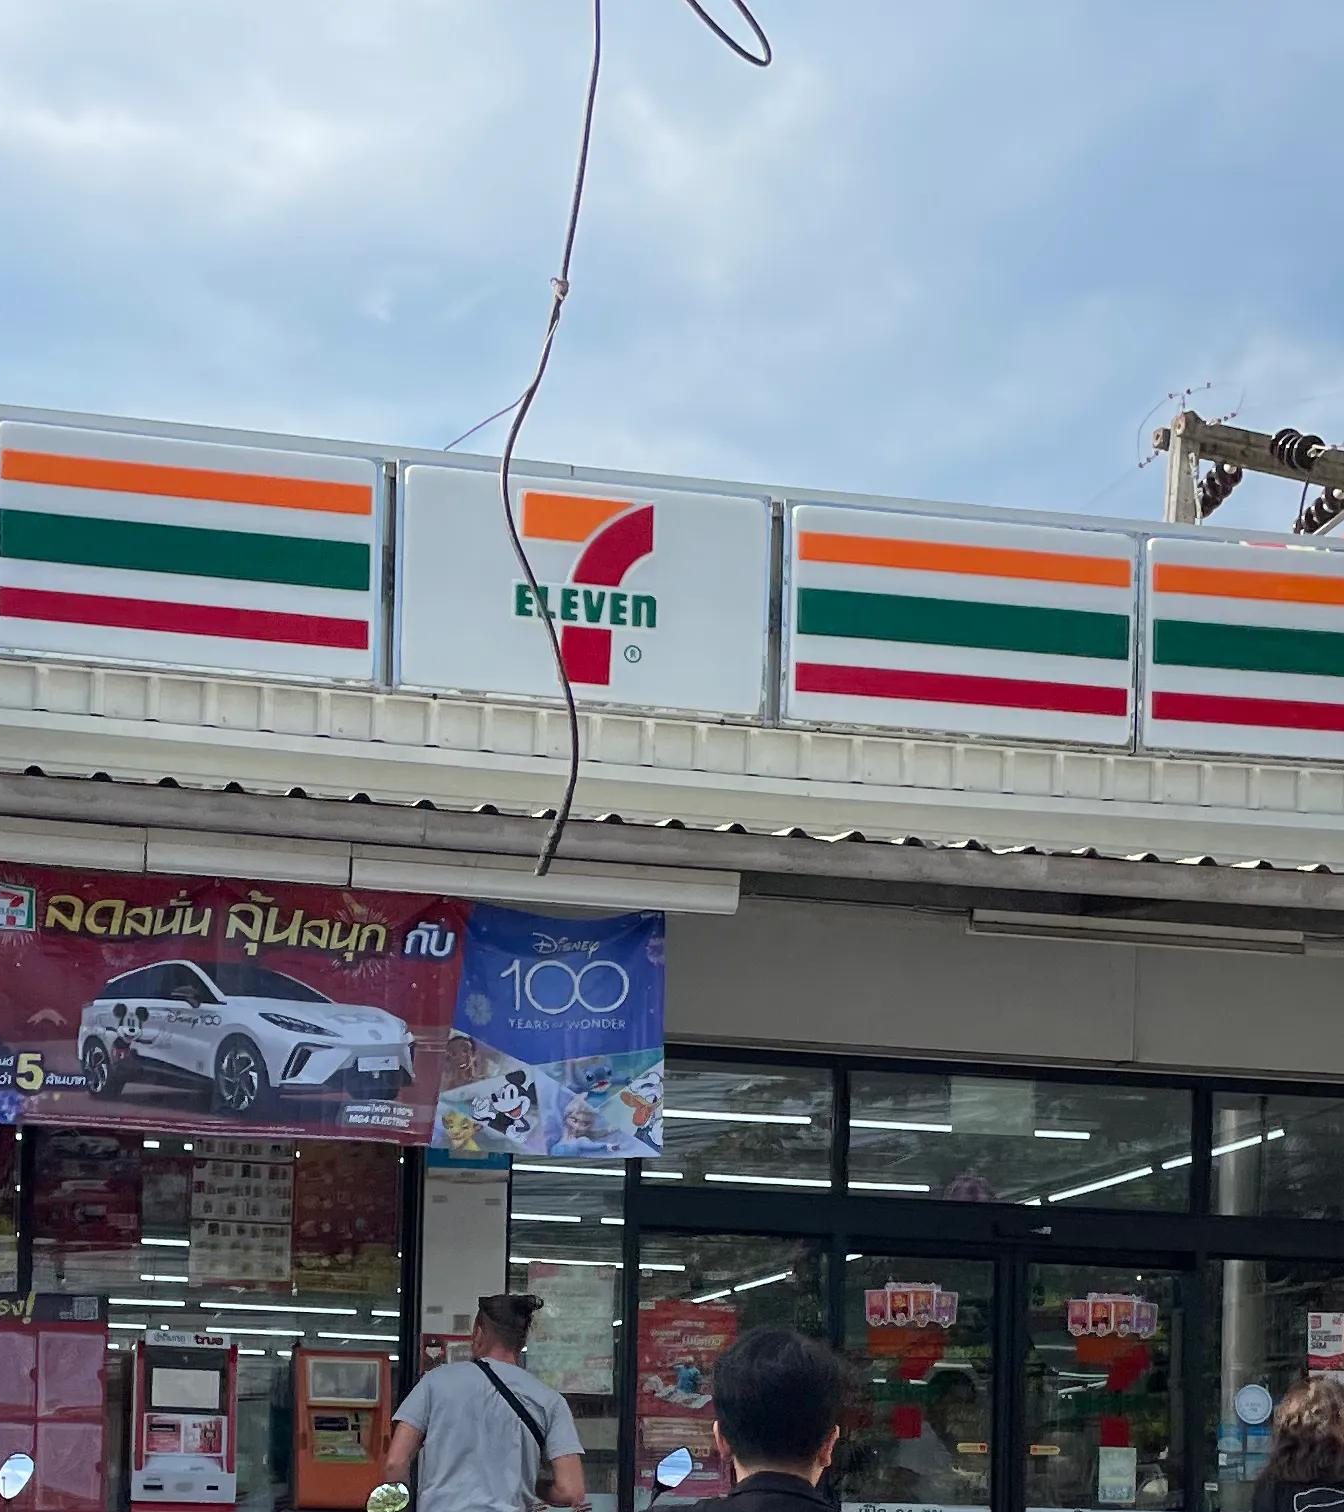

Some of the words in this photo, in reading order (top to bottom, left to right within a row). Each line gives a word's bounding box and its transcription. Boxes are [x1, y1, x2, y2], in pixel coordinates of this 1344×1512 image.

[404, 922, 456, 958] กับ
[500, 959, 630, 1015] 100
[509, 1018, 549, 1030] YEARS
[568, 1018, 626, 1030] WONDER
[16, 1053, 44, 1090] 5
[194, 1334, 224, 1346] true
